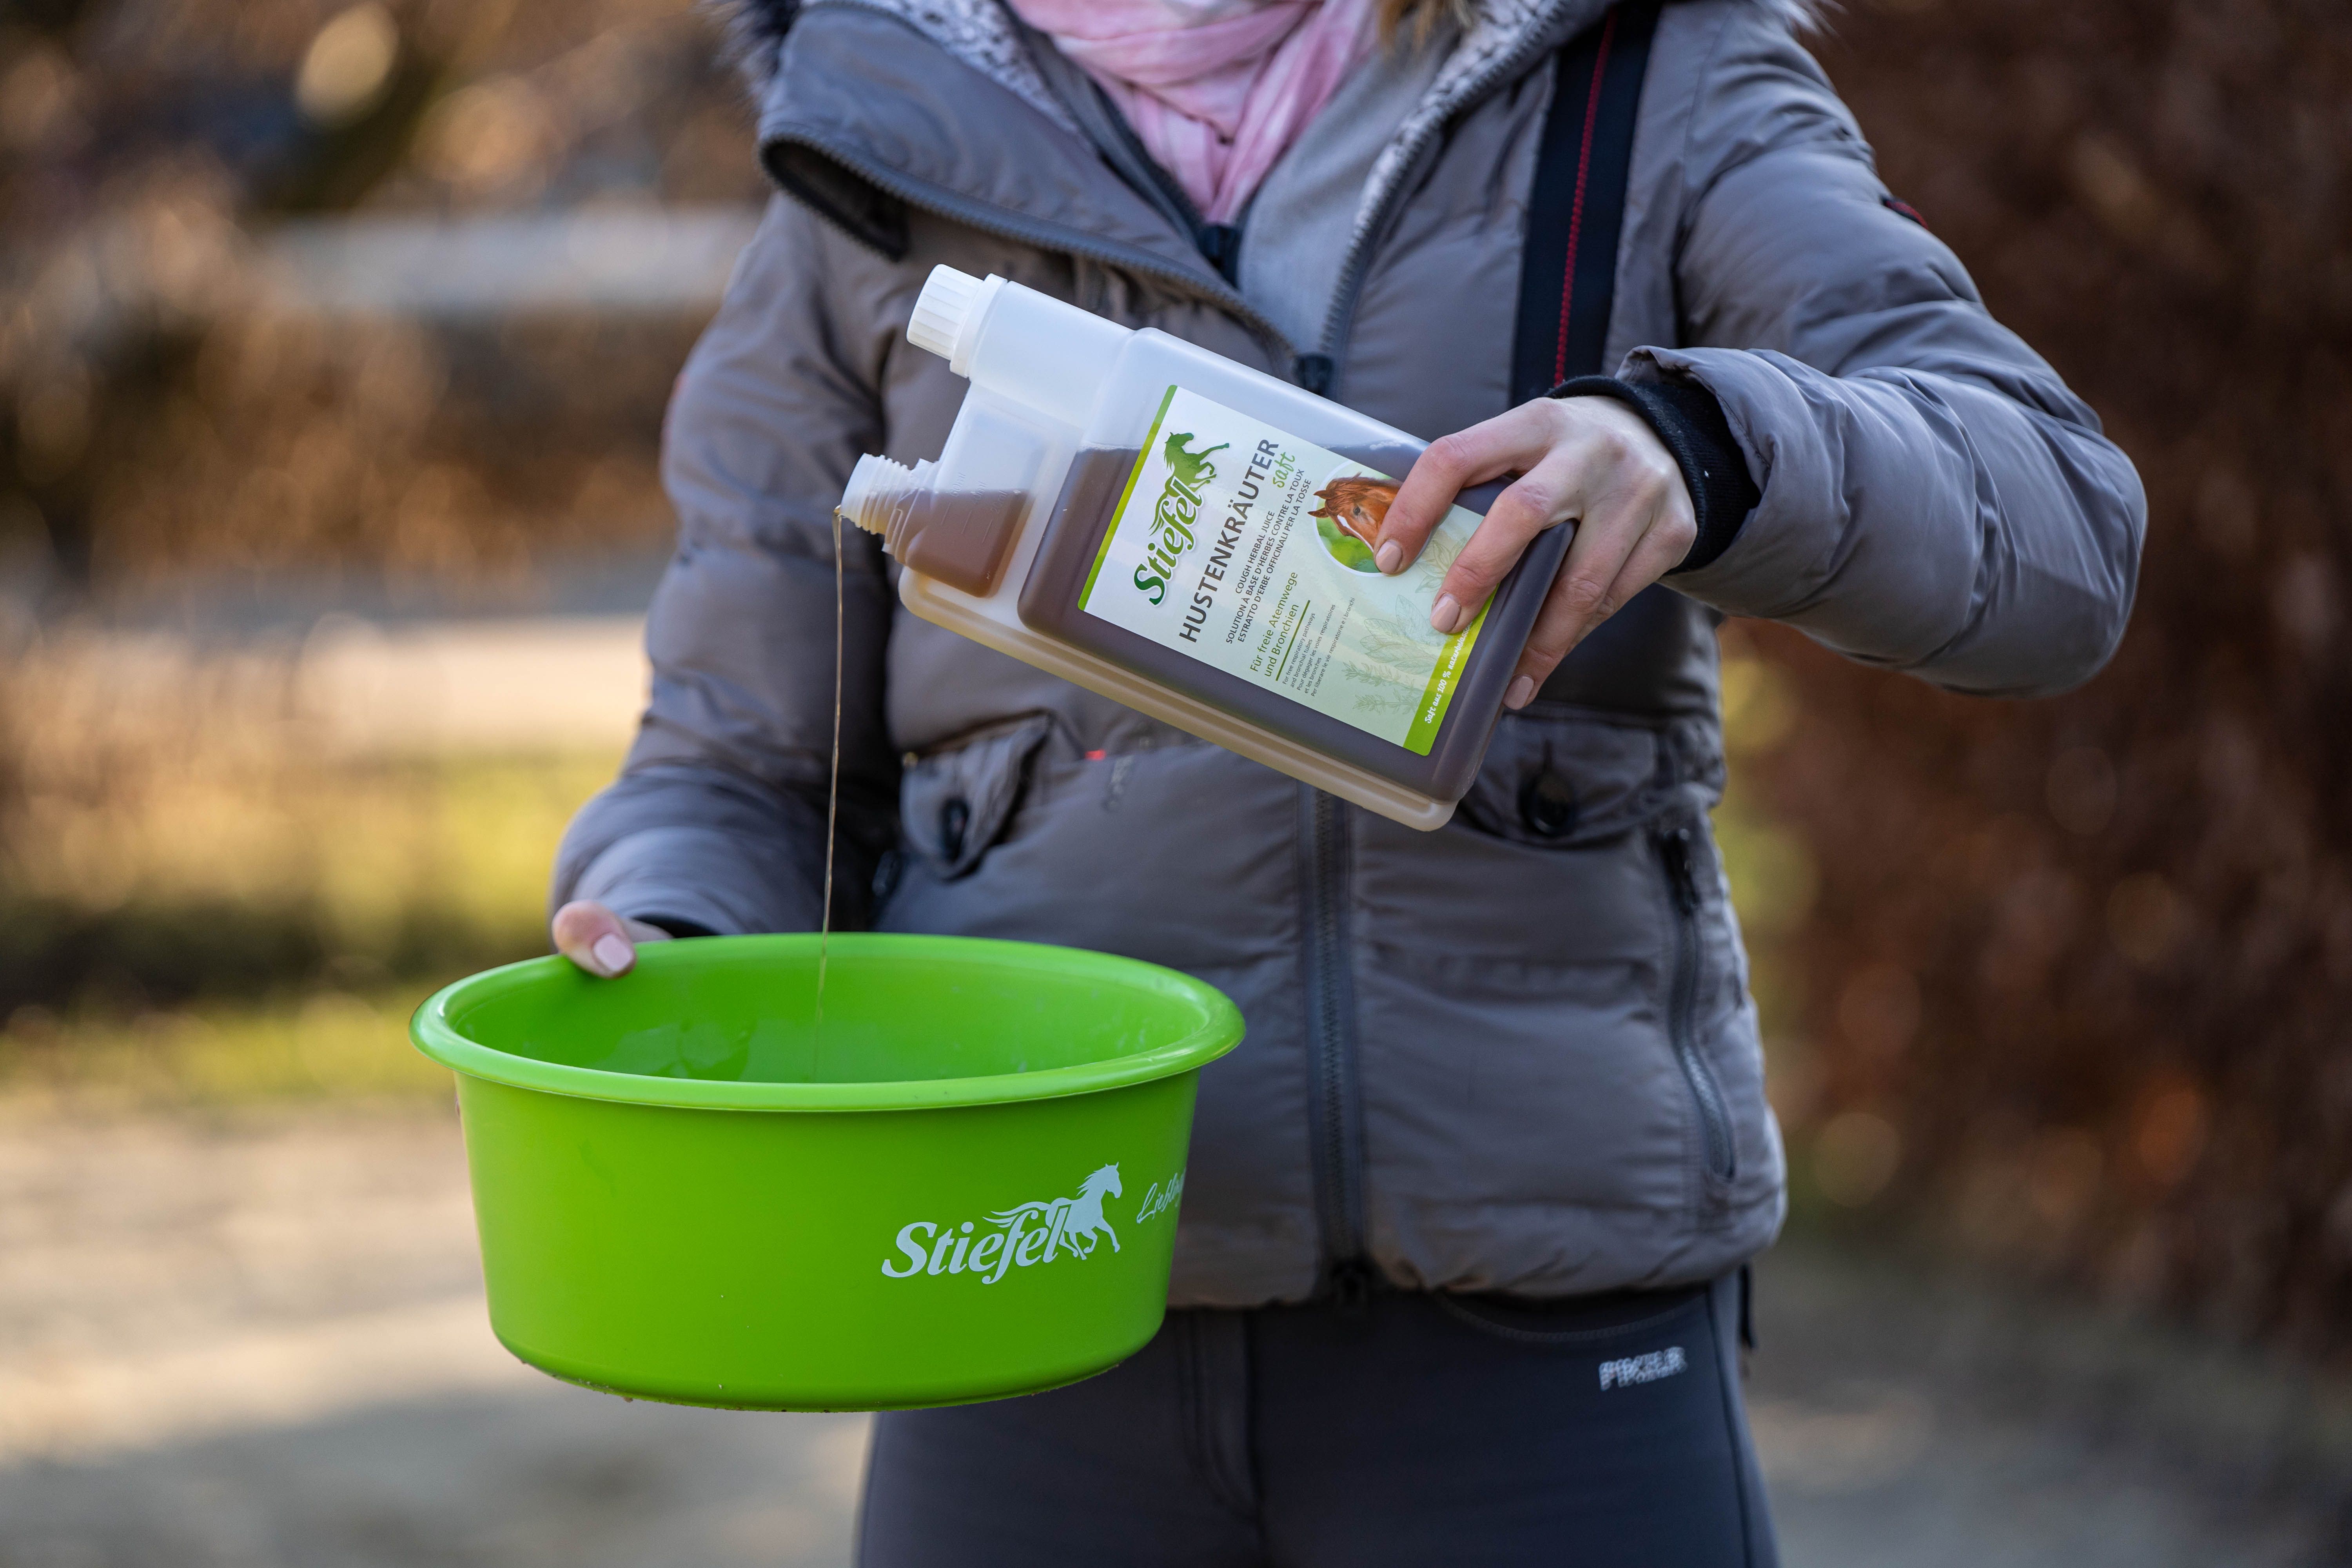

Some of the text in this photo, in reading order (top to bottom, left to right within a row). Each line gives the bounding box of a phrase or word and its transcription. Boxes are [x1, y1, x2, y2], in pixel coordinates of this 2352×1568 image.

[1272, 452, 1295, 488] saft
[1289, 469, 1305, 491] TOUX
[1285, 494, 1294, 504] LA
[1290, 506, 1301, 516] LA
[1295, 479, 1311, 503] TOSSE
[1271, 504, 1289, 535] CONTRE
[1284, 517, 1296, 532] PER
[1134, 479, 1202, 605] Stiefel
[1179, 439, 1279, 643] HUSTENKRÄUTER
[1235, 511, 1275, 593] COUGH HERBAL JUICE
[1266, 532, 1289, 573] OFFICINALI
[1245, 575, 1259, 596] BASE
[1226, 604, 1247, 644] SOLUTION
[1238, 604, 1258, 642] ESTRATTO
[1250, 572, 1298, 672] Für freie Atemwege
[1264, 604, 1299, 677] und Bronchien
[1285, 665, 1294, 675] free
[1291, 637, 1305, 665] respiratory
[1302, 613, 1315, 637] pathways
[1293, 653, 1307, 677] bronchial
[1303, 639, 1313, 653] tubes
[1296, 678, 1305, 691] Pour
[1302, 657, 1313, 678] dégager
[1314, 636, 1322, 649] voies
[1320, 604, 1336, 635] respiratoires
[1314, 668, 1326, 688] liberare
[1329, 625, 1344, 654] respiratorie
[1343, 597, 1355, 617] bronchi
[1308, 657, 1322, 680] bronches
[1425, 706, 1436, 723] Saft
[1432, 693, 1441, 706] aus
[1437, 679, 1447, 693] 100
[881, 1207, 1069, 1284] Stiefel
